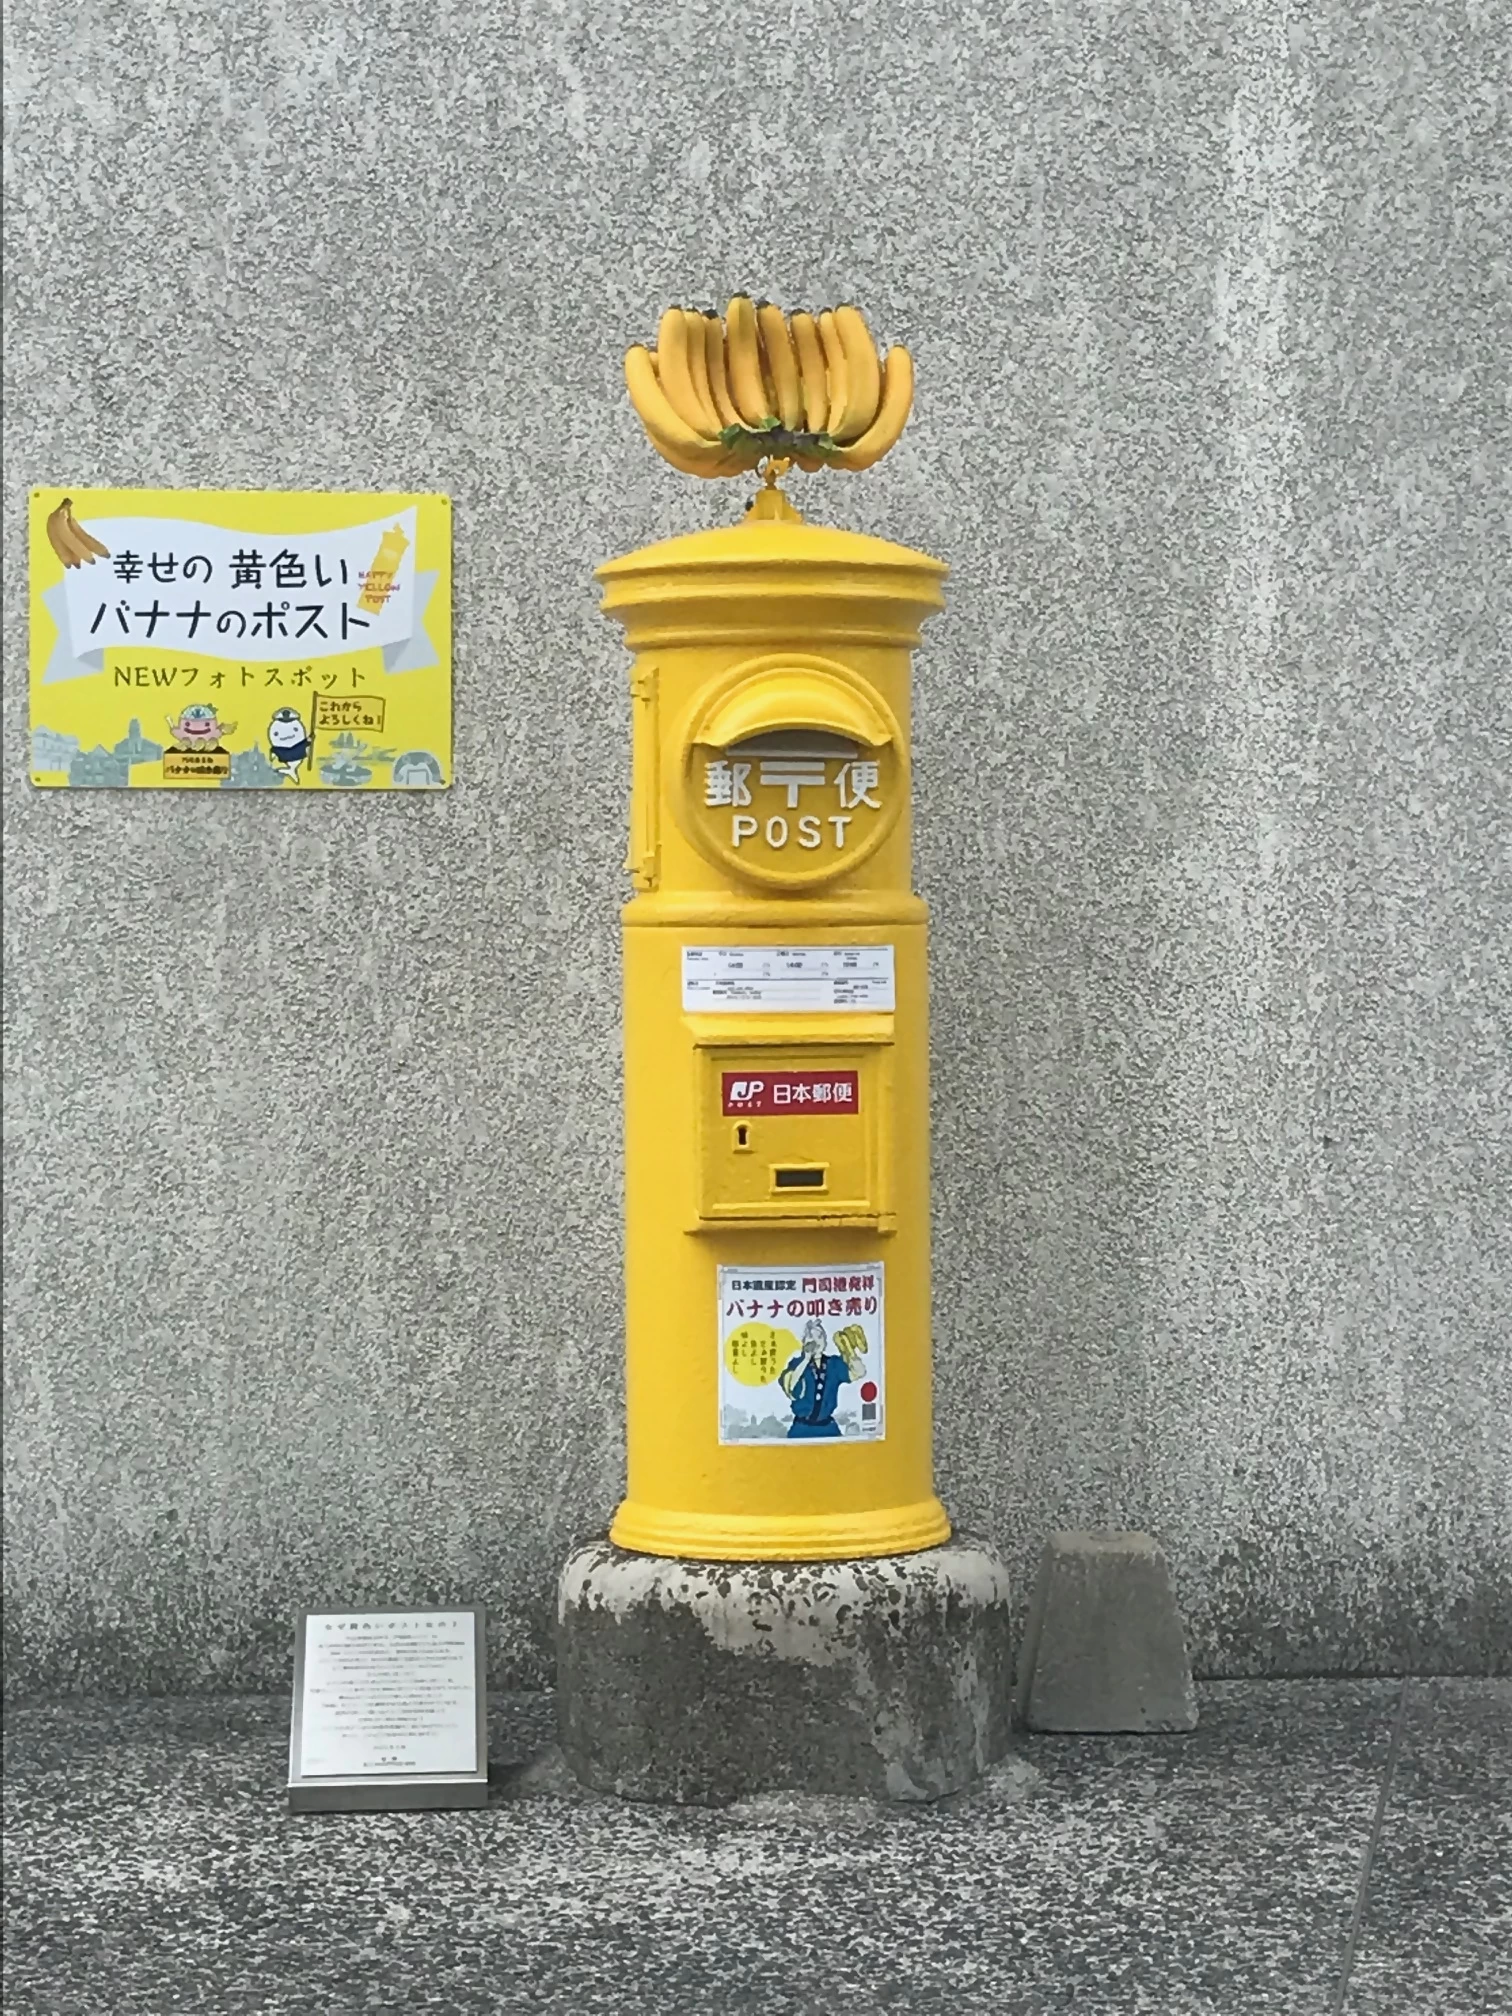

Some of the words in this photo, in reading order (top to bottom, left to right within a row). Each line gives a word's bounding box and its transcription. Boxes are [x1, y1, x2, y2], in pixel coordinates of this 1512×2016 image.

[113, 549, 213, 584] 幸せの
[228, 548, 348, 590] 黄色い
[357, 583, 400, 592] YELLOW
[90, 600, 371, 640] バナナのポスト
[114, 665, 366, 689] NEWフォトスポット
[319, 701, 362, 712] これから
[731, 814, 853, 848] POST
[773, 1082, 853, 1104] 日本郵便
[726, 1296, 878, 1318] バナナの叩き売り
